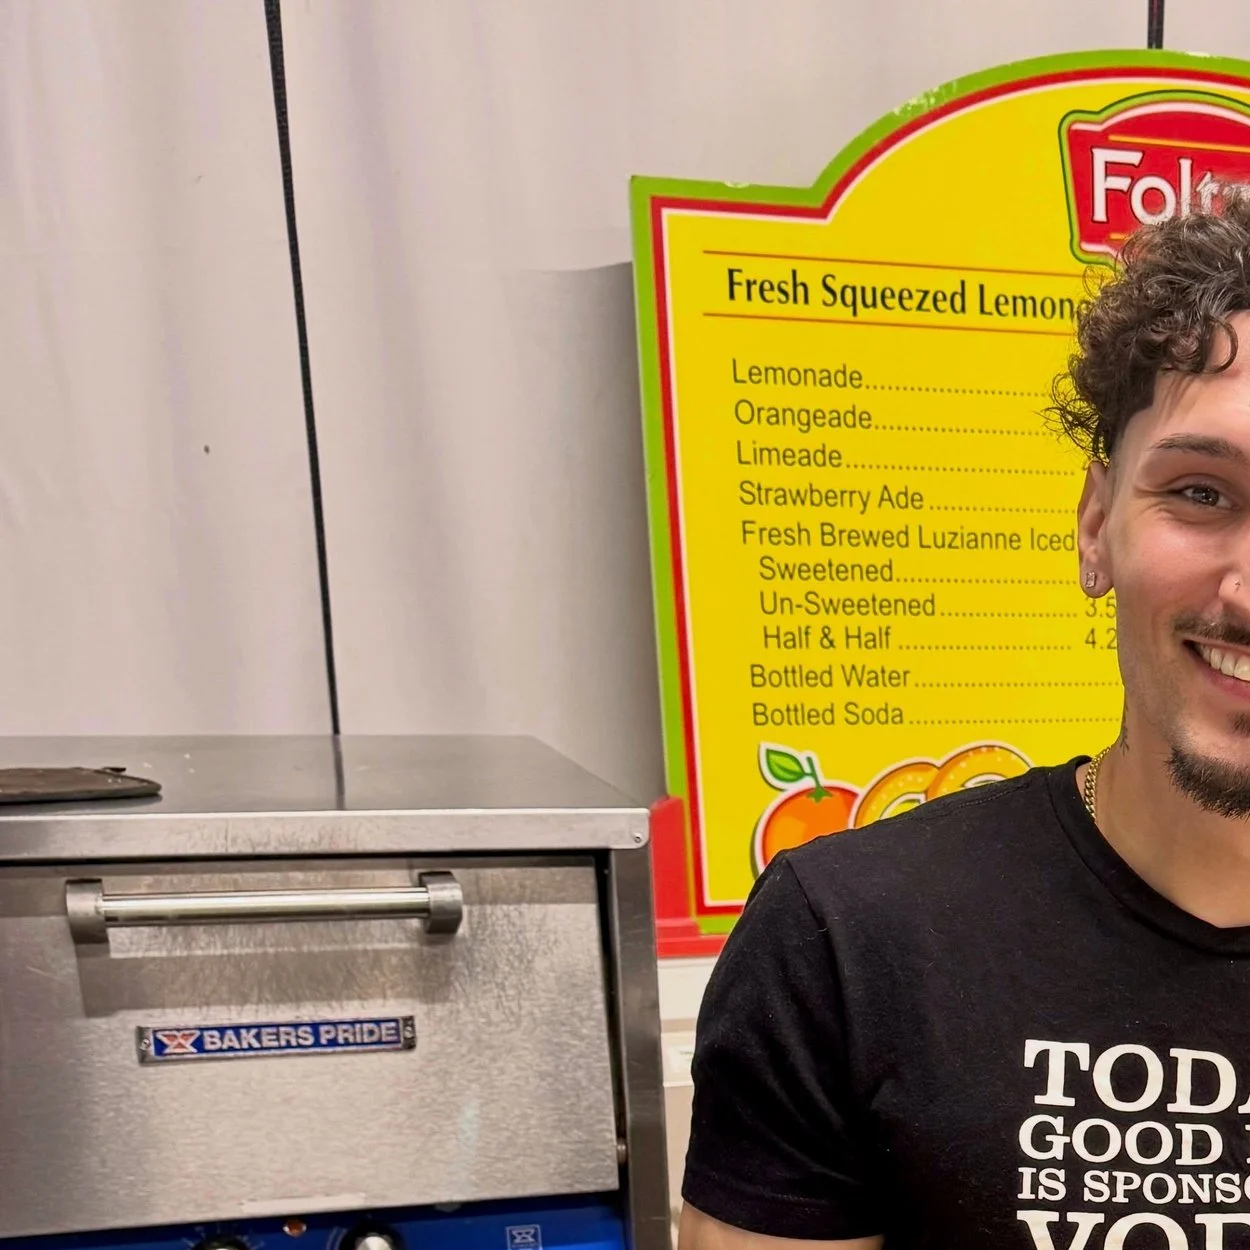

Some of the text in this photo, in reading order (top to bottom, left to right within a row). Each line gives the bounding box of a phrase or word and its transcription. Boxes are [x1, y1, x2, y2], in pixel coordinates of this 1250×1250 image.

[727, 268, 809, 306] Fresh
[822, 274, 965, 317] Squeezed
[733, 358, 863, 389] Lemonade
[735, 399, 872, 433] Orangeade
[736, 440, 842, 468] Limeade
[739, 480, 923, 514] Strawberry Ade
[742, 520, 1075, 551] Fresh Brewed Luzianne Iced
[759, 556, 893, 582] Sweetened
[760, 591, 935, 616] Un-Sweetened
[1085, 596, 1116, 618] 3.5
[763, 625, 892, 650] Half & Half
[1085, 627, 1116, 650] 4.2
[750, 664, 910, 688] Bottled Water
[753, 702, 903, 726] Bottled Soda
[203, 1021, 398, 1050] BAKERS PRIDE
[1018, 1114, 1223, 1166] GOOD
[1017, 1166, 1067, 1201] IS
